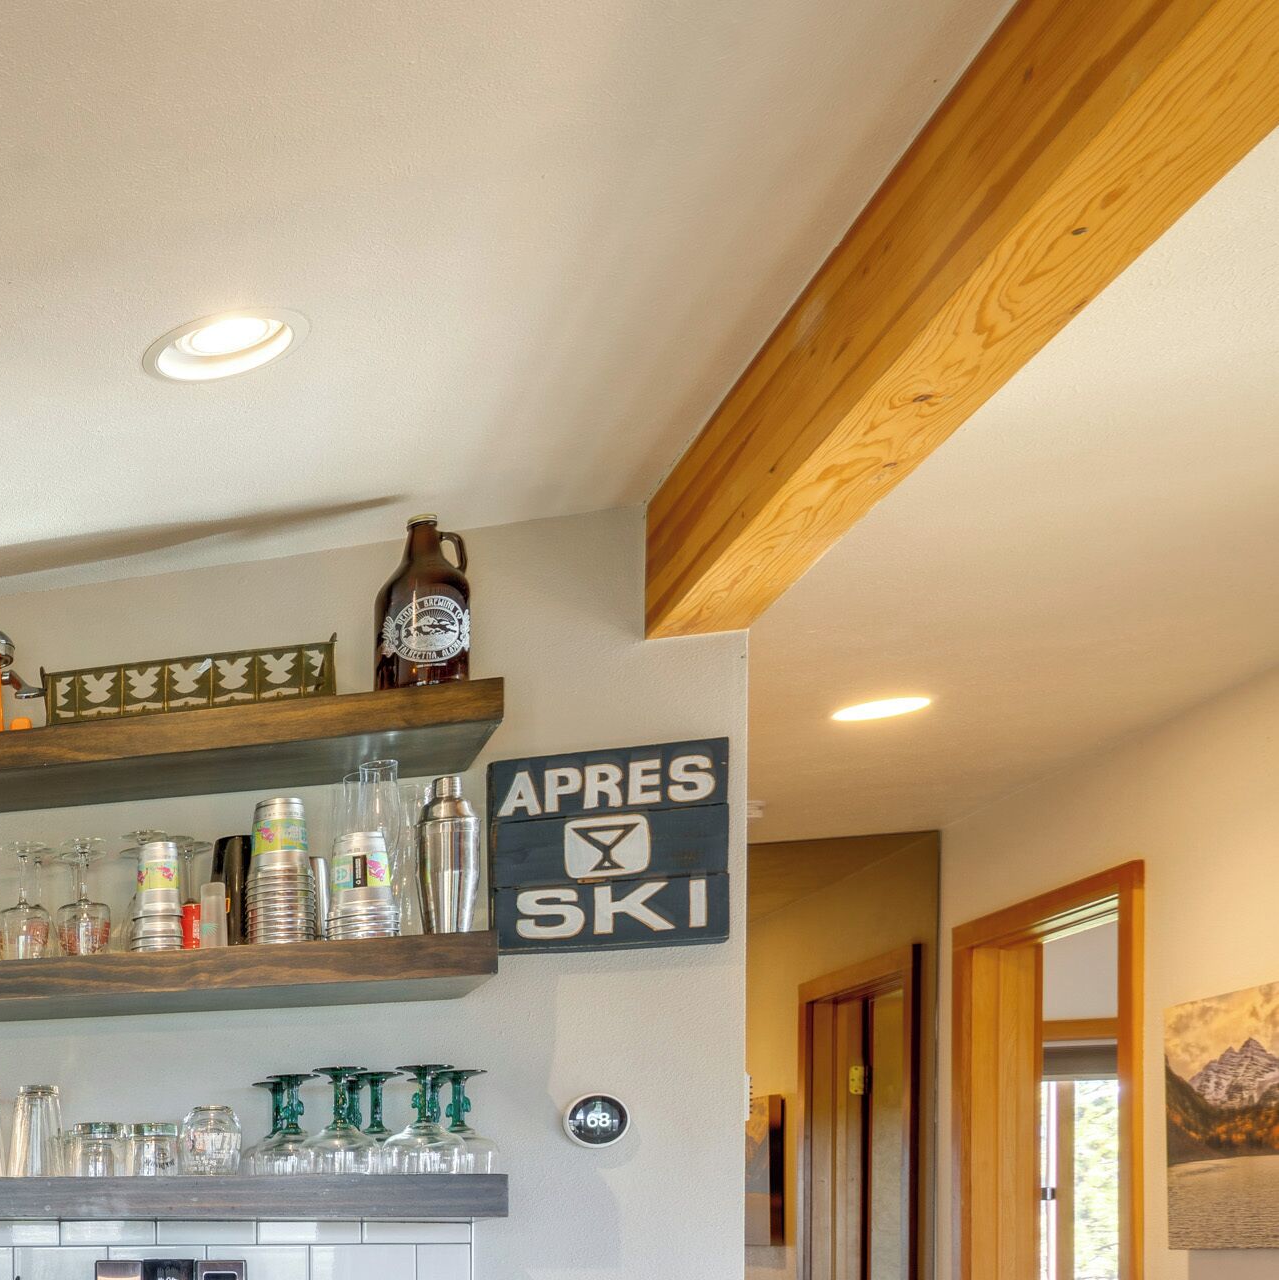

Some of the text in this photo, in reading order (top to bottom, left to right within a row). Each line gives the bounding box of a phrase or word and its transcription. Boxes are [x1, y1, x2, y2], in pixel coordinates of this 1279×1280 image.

[398, 602, 420, 625] DENAI
[424, 598, 455, 611] BREWING
[497, 755, 716, 817] APRES
[516, 879, 707, 939] SKI
[586, 1111, 610, 1128] 68
